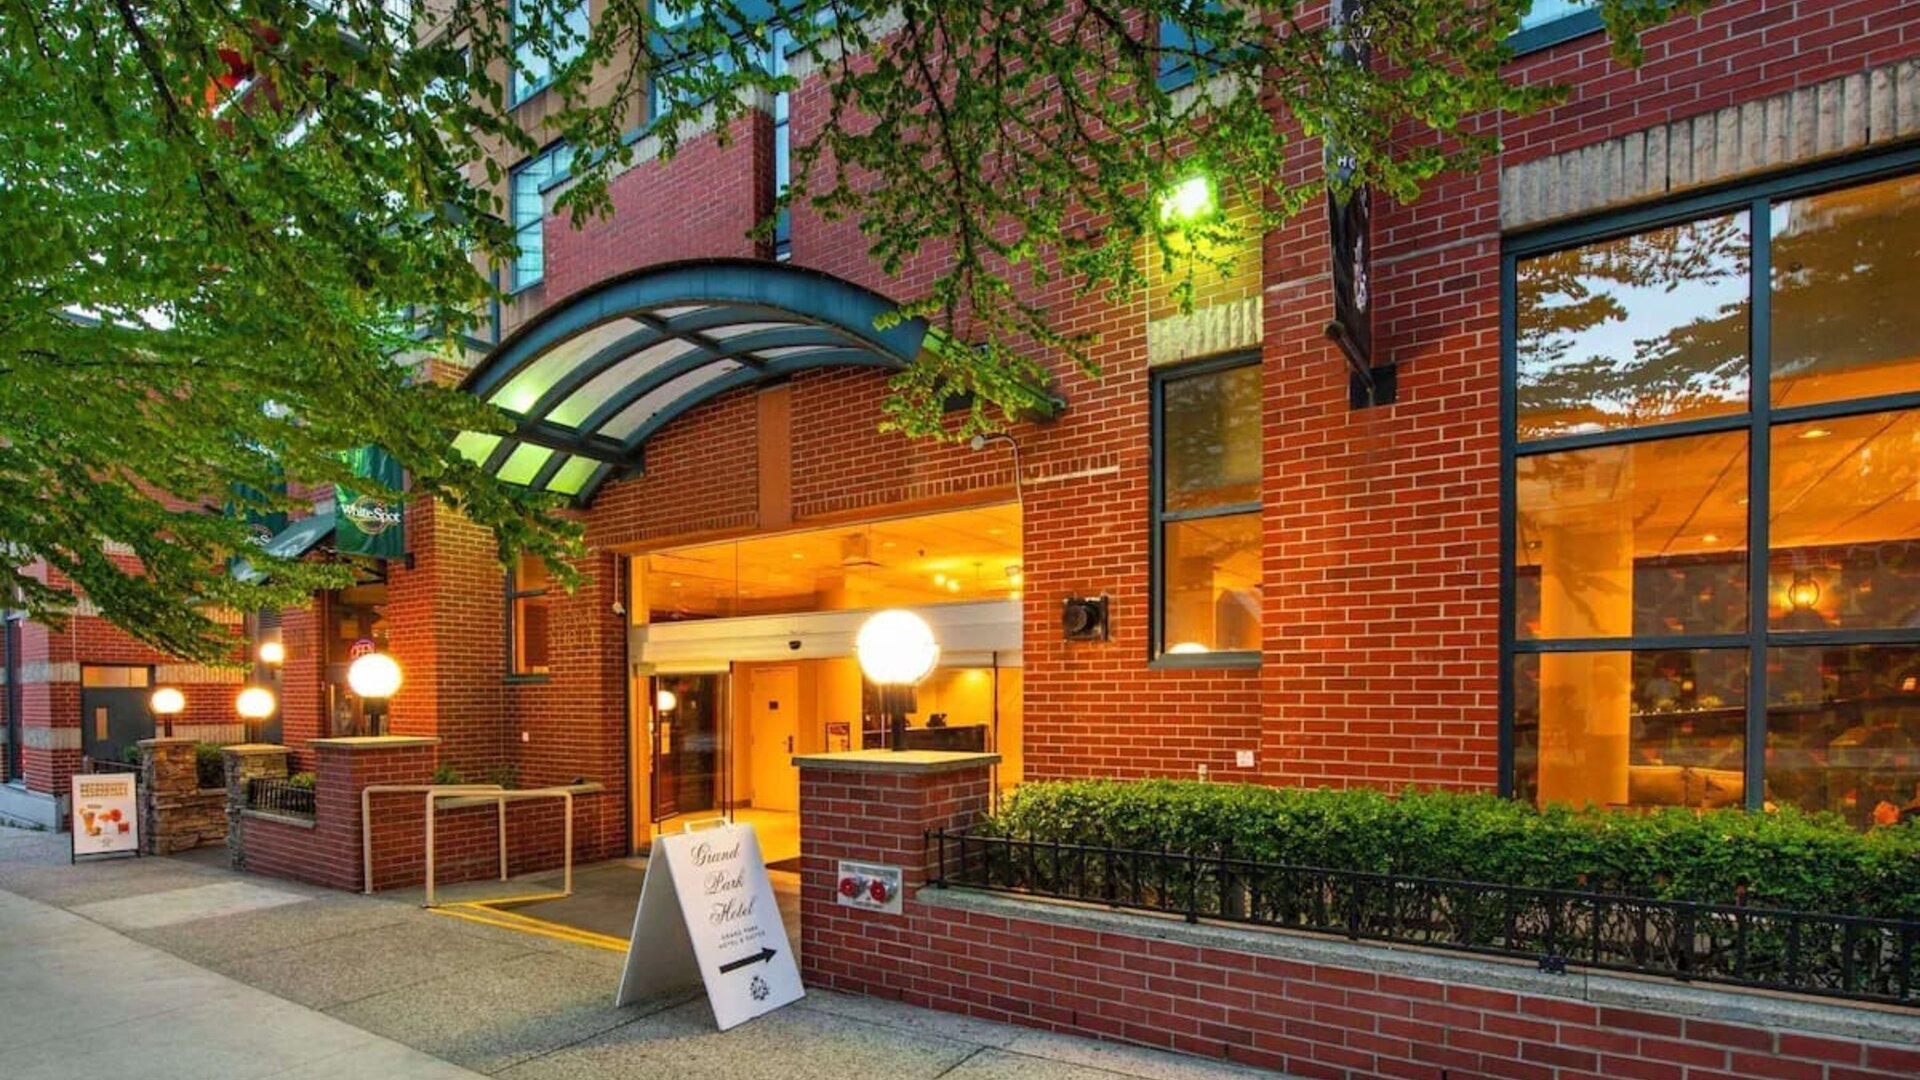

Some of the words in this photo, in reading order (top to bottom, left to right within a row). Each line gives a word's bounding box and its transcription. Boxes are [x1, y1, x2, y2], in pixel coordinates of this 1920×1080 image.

[691, 842, 740, 867] Grand
[704, 867, 745, 895] Park
[709, 895, 756, 926] Hotel
